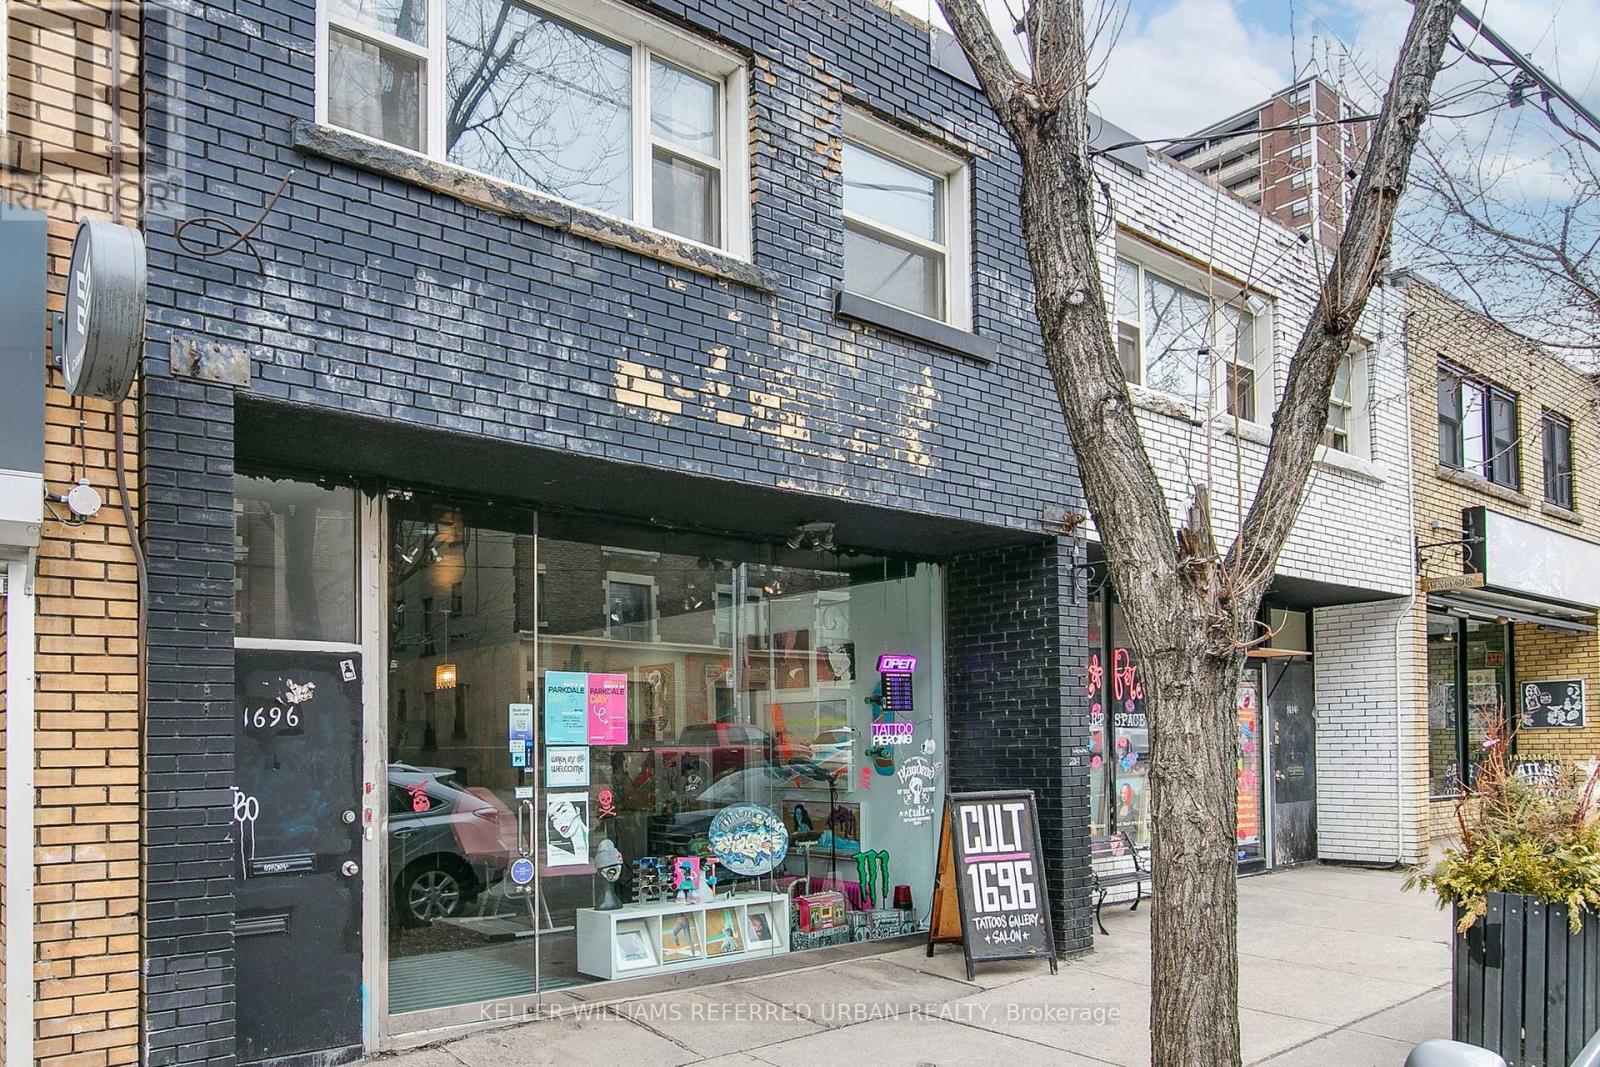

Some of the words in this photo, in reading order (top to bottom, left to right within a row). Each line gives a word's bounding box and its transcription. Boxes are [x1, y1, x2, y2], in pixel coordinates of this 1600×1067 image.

[883, 658, 917, 669] OPEN
[548, 686, 585, 694] PARKDALE
[590, 688, 625, 696] PARKDALE
[243, 706, 299, 728] 1696
[872, 723, 913, 736] TATTOO
[960, 803, 1025, 854] CULT
[967, 861, 1037, 913] 1696
[972, 915, 1007, 930] TATTOOS
[1008, 913, 1040, 928] GALLERY
[992, 930, 1023, 944] SALON
